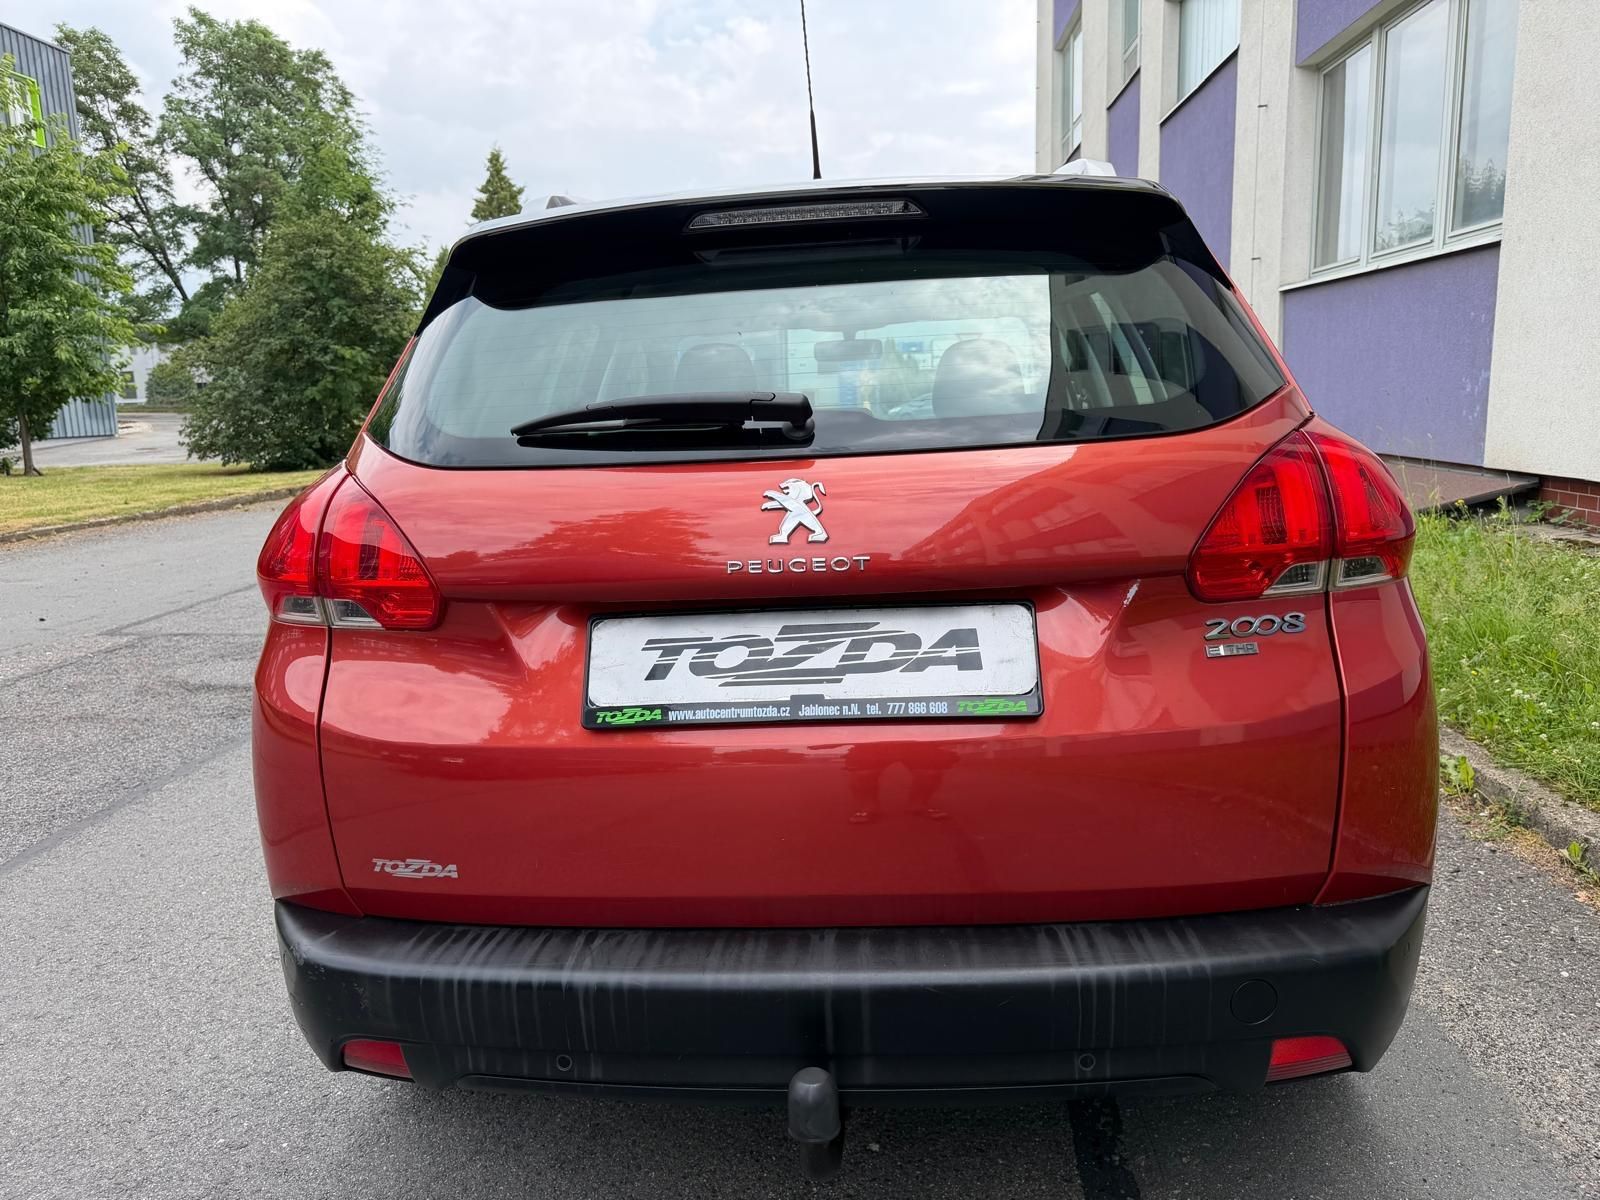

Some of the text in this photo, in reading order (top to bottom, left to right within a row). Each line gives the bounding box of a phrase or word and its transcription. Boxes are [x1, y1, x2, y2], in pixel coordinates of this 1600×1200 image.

[727, 556, 871, 574] PEUGEOT
[1204, 611, 1306, 640] 2008
[641, 622, 983, 687] TOZDA
[596, 699, 1027, 725] TOZDA www.autocentrumtozda.cz Jablonec n.N. tel. 777 866 608 TOZDA
[372, 858, 459, 878] TOZDA
